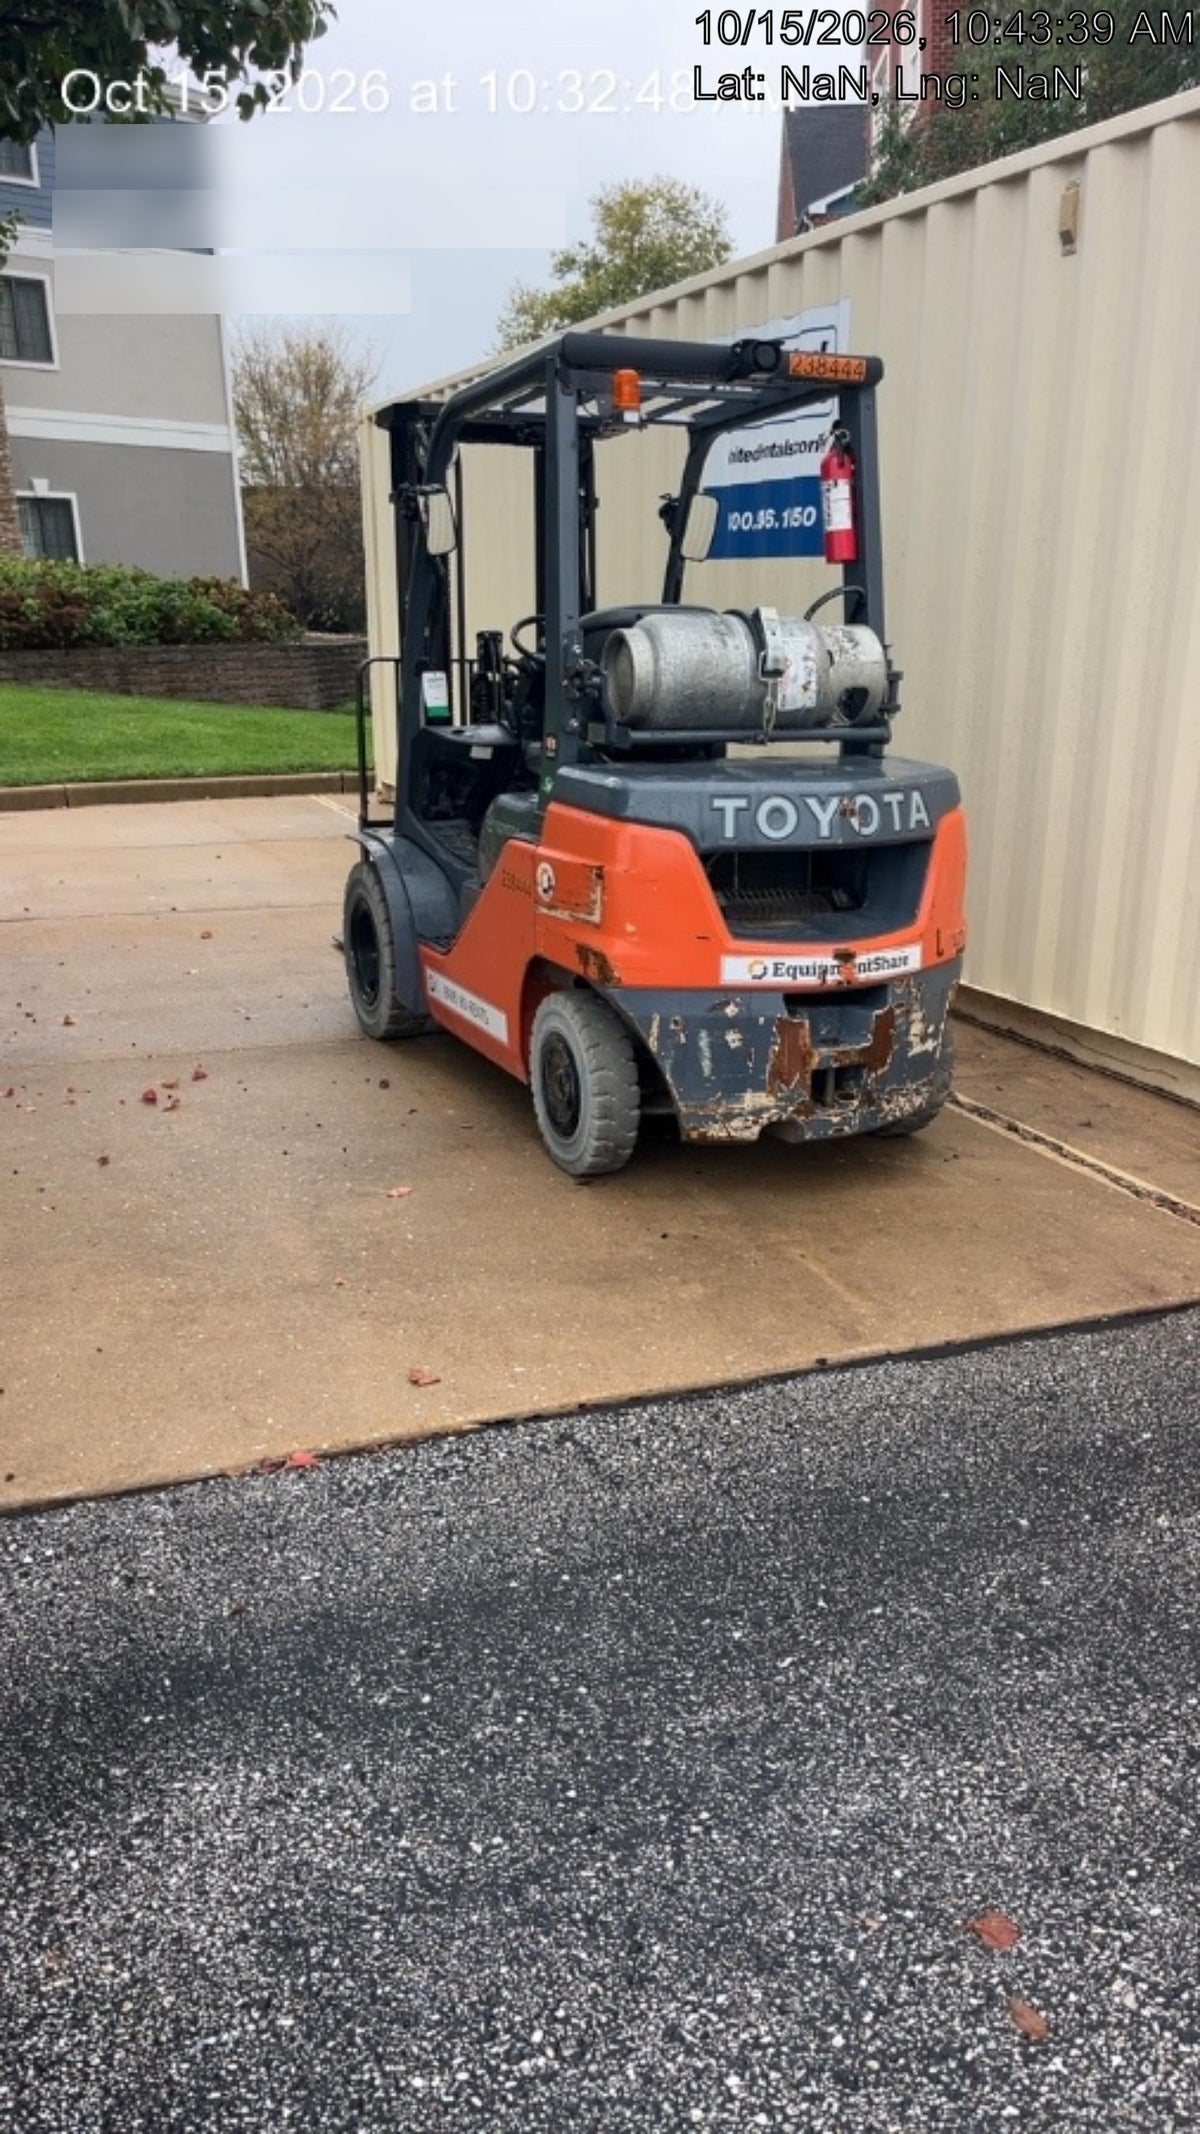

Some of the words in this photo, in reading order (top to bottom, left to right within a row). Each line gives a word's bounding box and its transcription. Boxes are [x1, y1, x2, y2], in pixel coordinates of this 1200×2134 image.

[791, 356, 863, 379] 238444
[713, 791, 930, 840] TOYOTA
[773, 955, 909, 980] EquipmntShare
